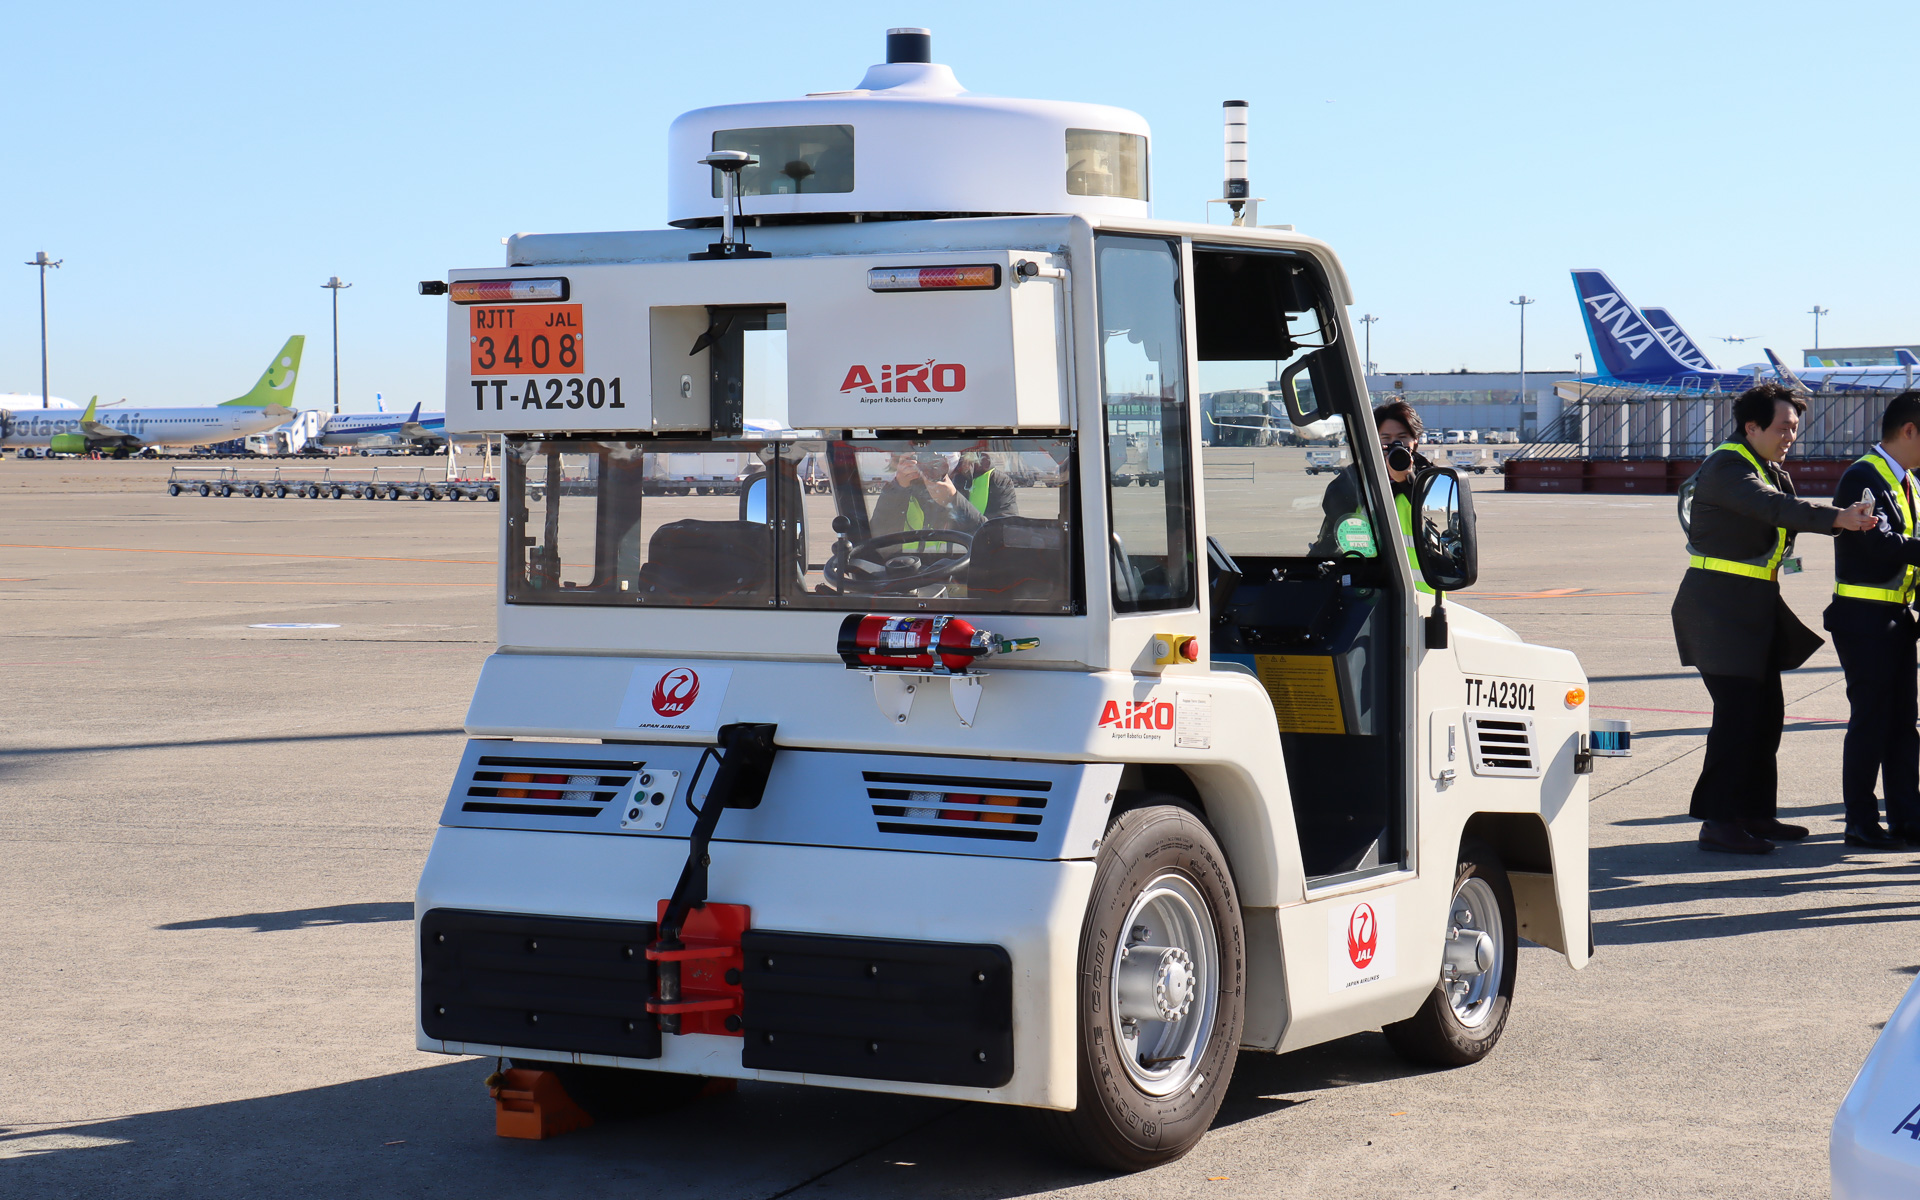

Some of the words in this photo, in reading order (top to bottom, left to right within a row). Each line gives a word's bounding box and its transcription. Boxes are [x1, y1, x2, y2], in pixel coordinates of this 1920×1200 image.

[477, 309, 515, 329] RJTT
[545, 312, 577, 327] JAL
[1584, 292, 1656, 360] ANA
[478, 334, 577, 369] 3408
[1655, 325, 1706, 369] ANA
[471, 377, 625, 411] TT-A2301
[913, 396, 944, 404] Company
[114, 412, 147, 435] Air
[1465, 679, 1535, 710] TT-A2301
[659, 702, 684, 712] JAL
[1112, 732, 1127, 740] Airport
[1143, 733, 1161, 741] Company
[1355, 948, 1373, 963] JAL
[1092, 929, 1109, 1014] COIN
[1345, 980, 1359, 988] JAPAN
[1360, 974, 1380, 984] AIRLINES
